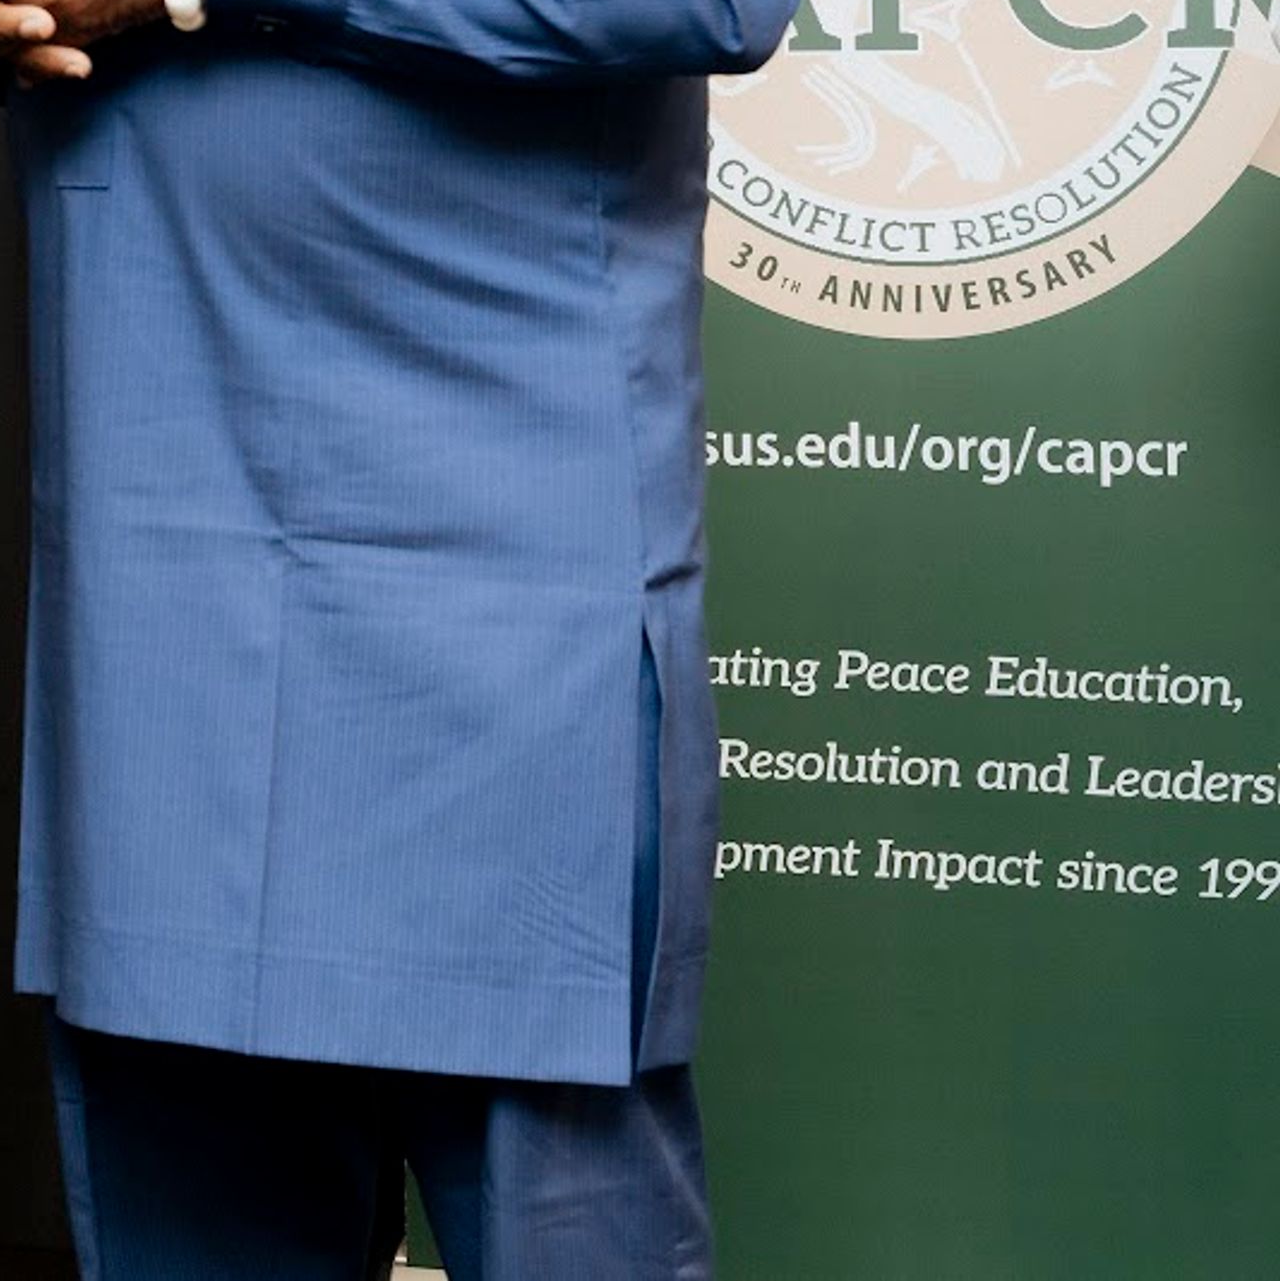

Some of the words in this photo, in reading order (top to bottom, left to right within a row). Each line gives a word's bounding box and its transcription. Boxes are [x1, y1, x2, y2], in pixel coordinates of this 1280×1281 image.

[715, 159, 937, 254] CONFLICT
[953, 61, 1204, 253] RESOLUTION
[817, 234, 1118, 315] ANNIVERSARY
[833, 649, 970, 695] Peace
[984, 654, 1244, 714] Education,
[717, 737, 961, 789] Resolution
[976, 752, 1069, 795] and
[1083, 754, 1280, 806] Leaders
[713, 838, 861, 880] pment
[874, 838, 1043, 890] Impact
[1056, 849, 1179, 896] since
